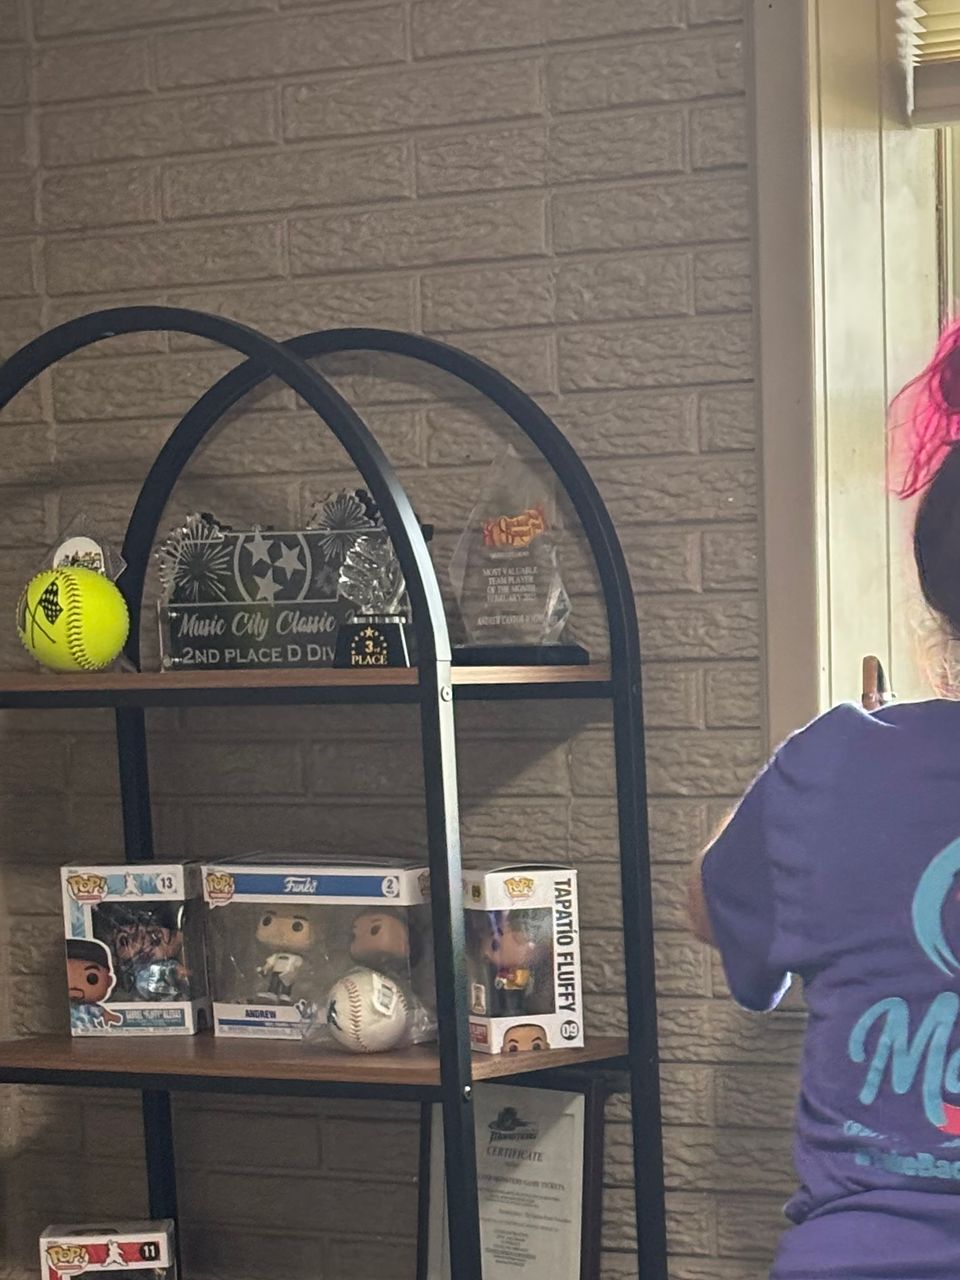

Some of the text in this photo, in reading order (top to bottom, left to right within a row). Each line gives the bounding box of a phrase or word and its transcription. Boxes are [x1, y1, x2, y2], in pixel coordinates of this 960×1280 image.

[178, 611, 226, 638] Music
[231, 611, 270, 641] City
[276, 609, 337, 636] Classic
[182, 647, 220, 664] 2ND
[225, 647, 282, 663] PLACE
[287, 644, 302, 662] D
[351, 655, 388, 665] PLACE
[67, 873, 107, 896] POP!
[160, 878, 173, 889] 13
[206, 874, 233, 893] POP!
[283, 876, 318, 893] Funko
[386, 878, 394, 890] 2
[554, 878, 578, 1013] TAPATÍO FLUFFY
[245, 1009, 277, 1019] ANDREW
[560, 1022, 578, 1039] 09
[486, 1146, 544, 1162] CERTIFICATE
[47, 1246, 86, 1267] POP!
[143, 1245, 155, 1257] 11
